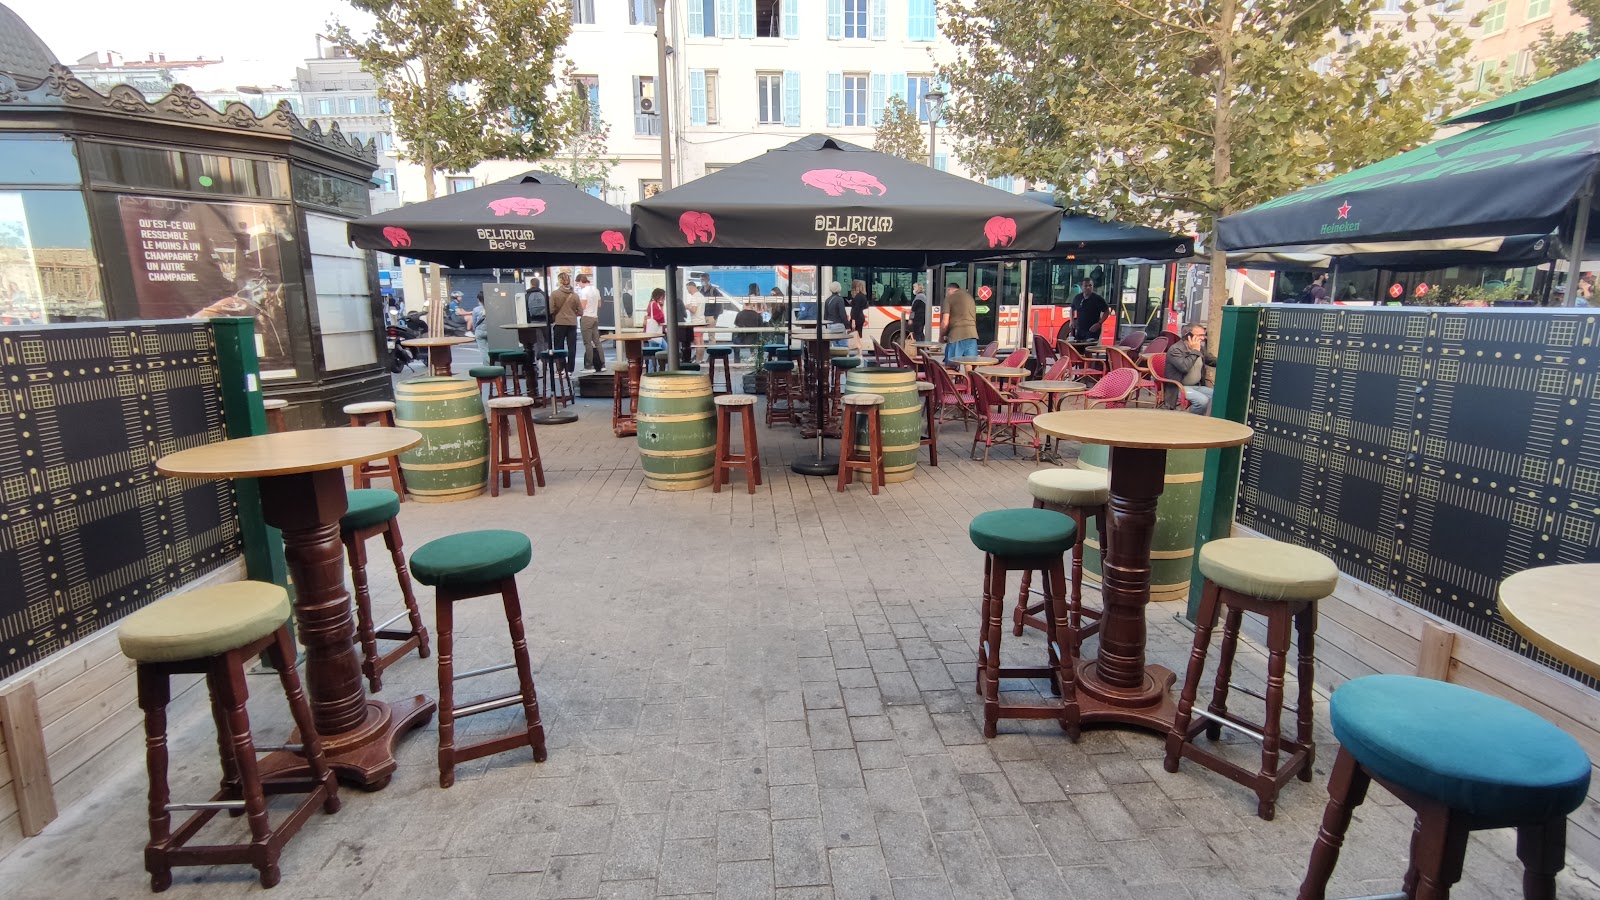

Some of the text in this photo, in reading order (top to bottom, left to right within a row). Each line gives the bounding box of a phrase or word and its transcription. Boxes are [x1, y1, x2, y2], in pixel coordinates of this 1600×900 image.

[139, 219, 196, 231] QU'EST-CE QUI
[815, 214, 894, 232] DELIRIUM
[1319, 221, 1360, 235] Heineken
[141, 230, 189, 240] RESSEMBLE
[477, 228, 535, 240] DELIRIUM
[143, 240, 201, 251] LE MOINS À UN
[489, 240, 527, 250] Beers
[826, 232, 878, 248] Beers
[147, 262, 186, 271] UN AUTRE
[148, 272, 199, 282] CHAMPAGNE.
